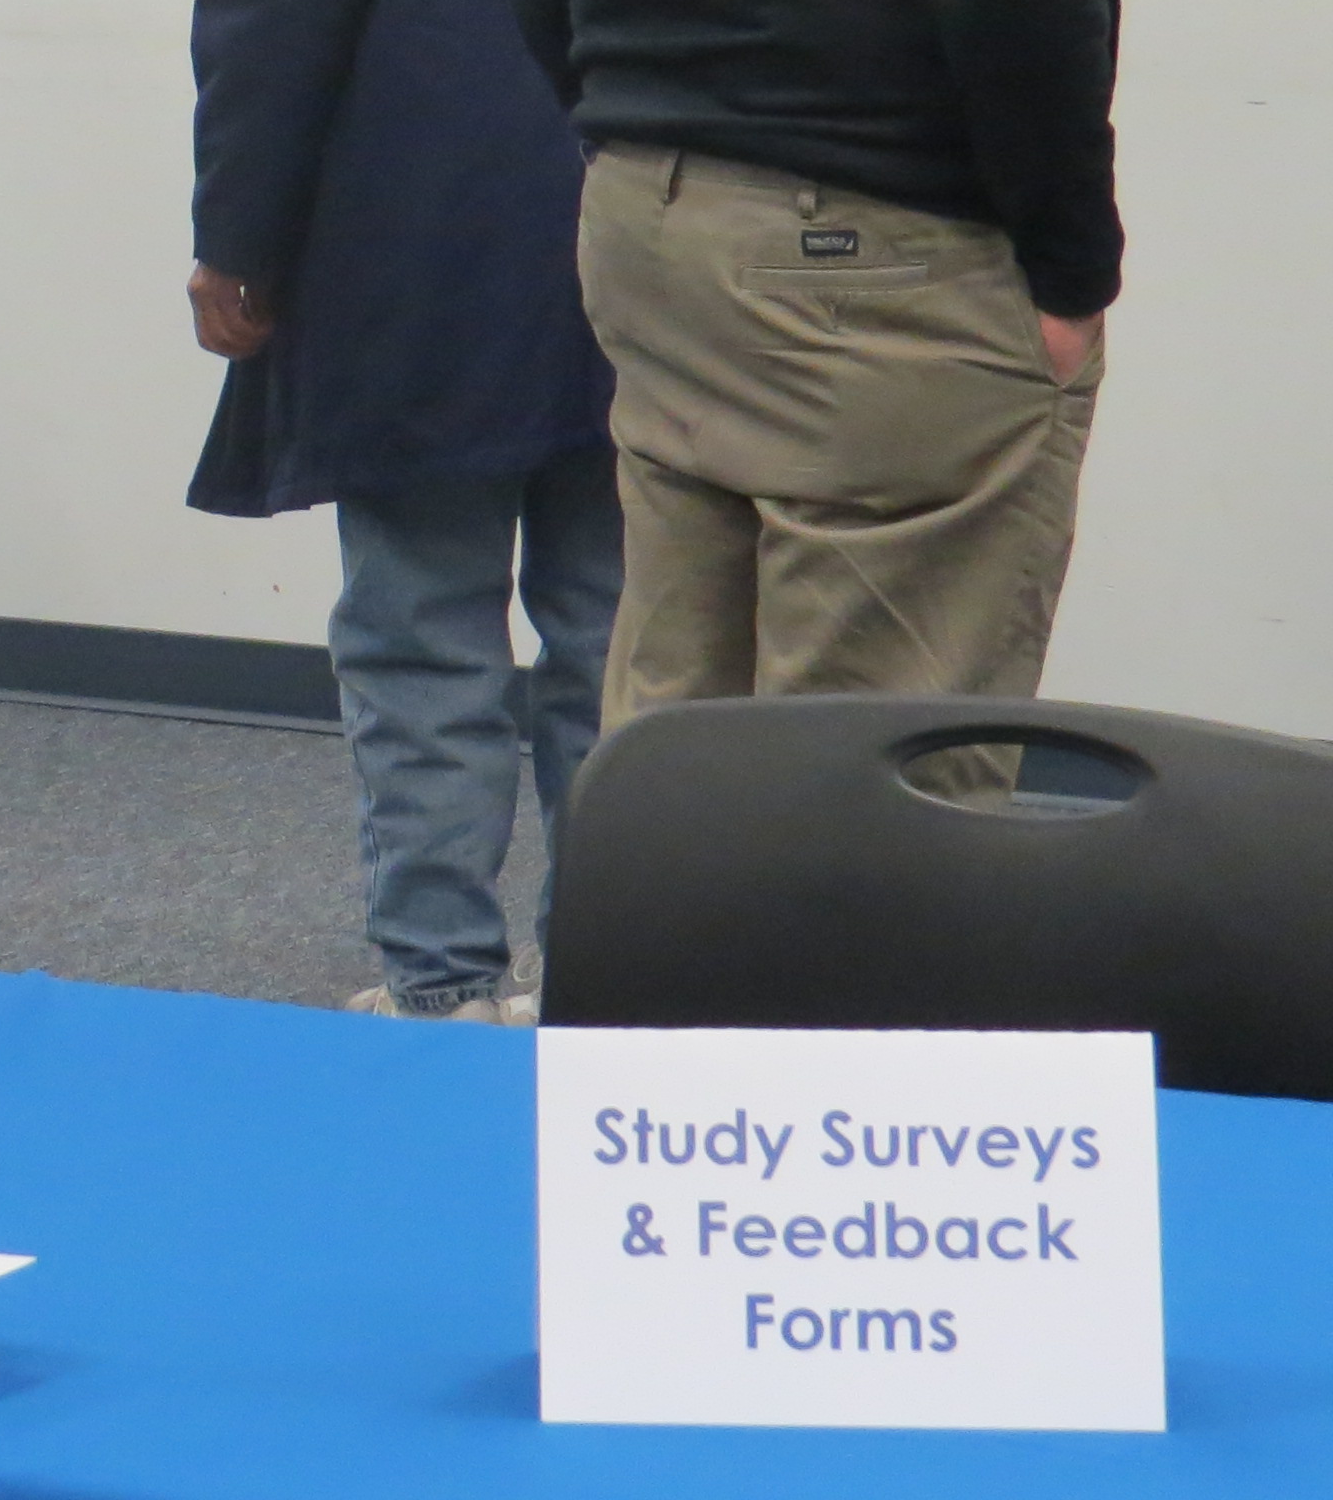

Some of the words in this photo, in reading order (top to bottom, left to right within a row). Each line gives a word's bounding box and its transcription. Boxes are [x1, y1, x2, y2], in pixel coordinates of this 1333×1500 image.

[593, 1106, 794, 1180] Study
[820, 1109, 1101, 1183] Surveys
[621, 1202, 667, 1257] &
[698, 1200, 1079, 1261] Feedback
[745, 1293, 959, 1354] Forms
